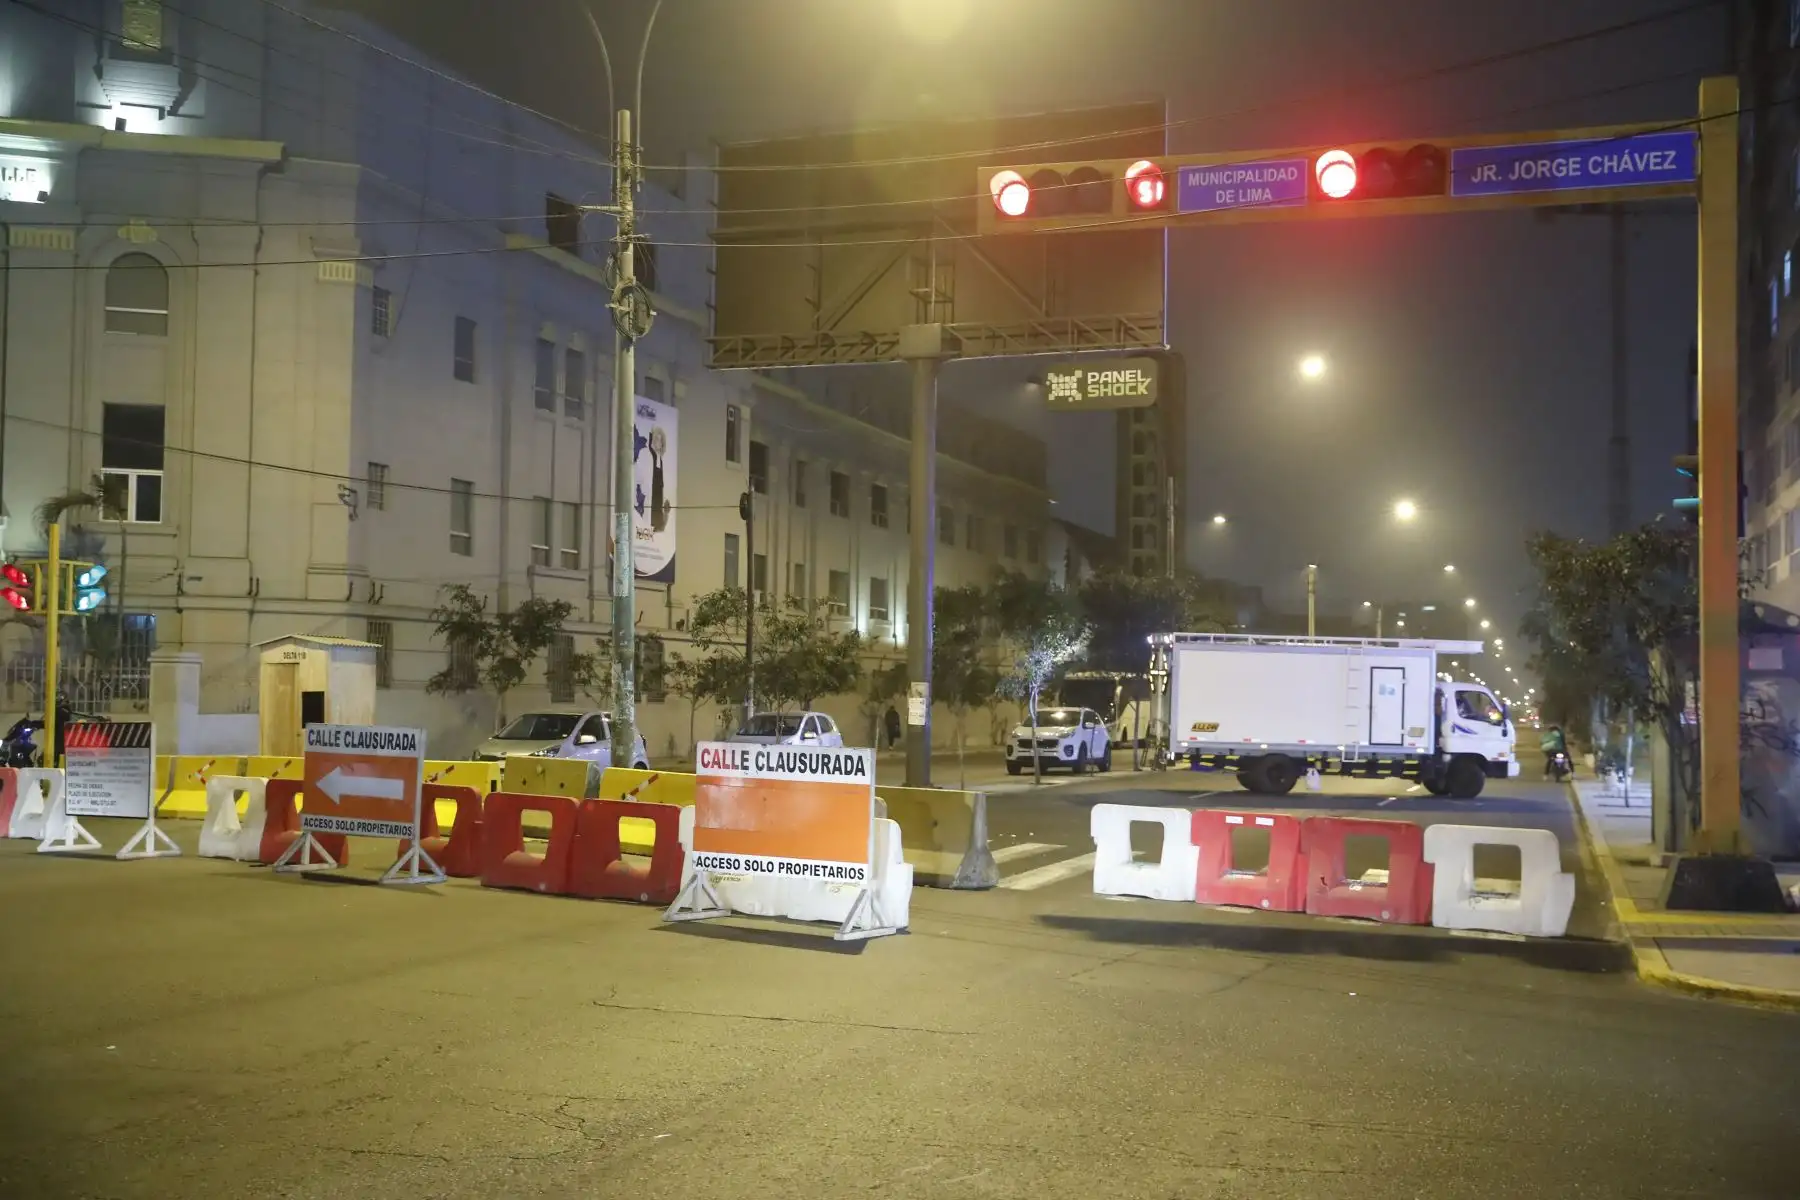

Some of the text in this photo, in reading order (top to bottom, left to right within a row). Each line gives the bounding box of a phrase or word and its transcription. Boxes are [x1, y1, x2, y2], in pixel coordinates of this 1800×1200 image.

[1188, 166, 1298, 187] MUNICIPALIDAD
[1471, 149, 1677, 183] JR. JORGE CHÁVEZ
[1216, 187, 1273, 204] DE LIMA
[1087, 370, 1146, 385] PANEL
[1087, 378, 1152, 397] SHOCK
[308, 728, 416, 751] CALLE CLAUSURADA
[701, 748, 866, 777] CALLE CLAUSURADA
[304, 818, 413, 837] ACCESO SOLO PROPIETARIOS
[695, 856, 864, 881] ACCESO SOLO PROPIETARIOS
